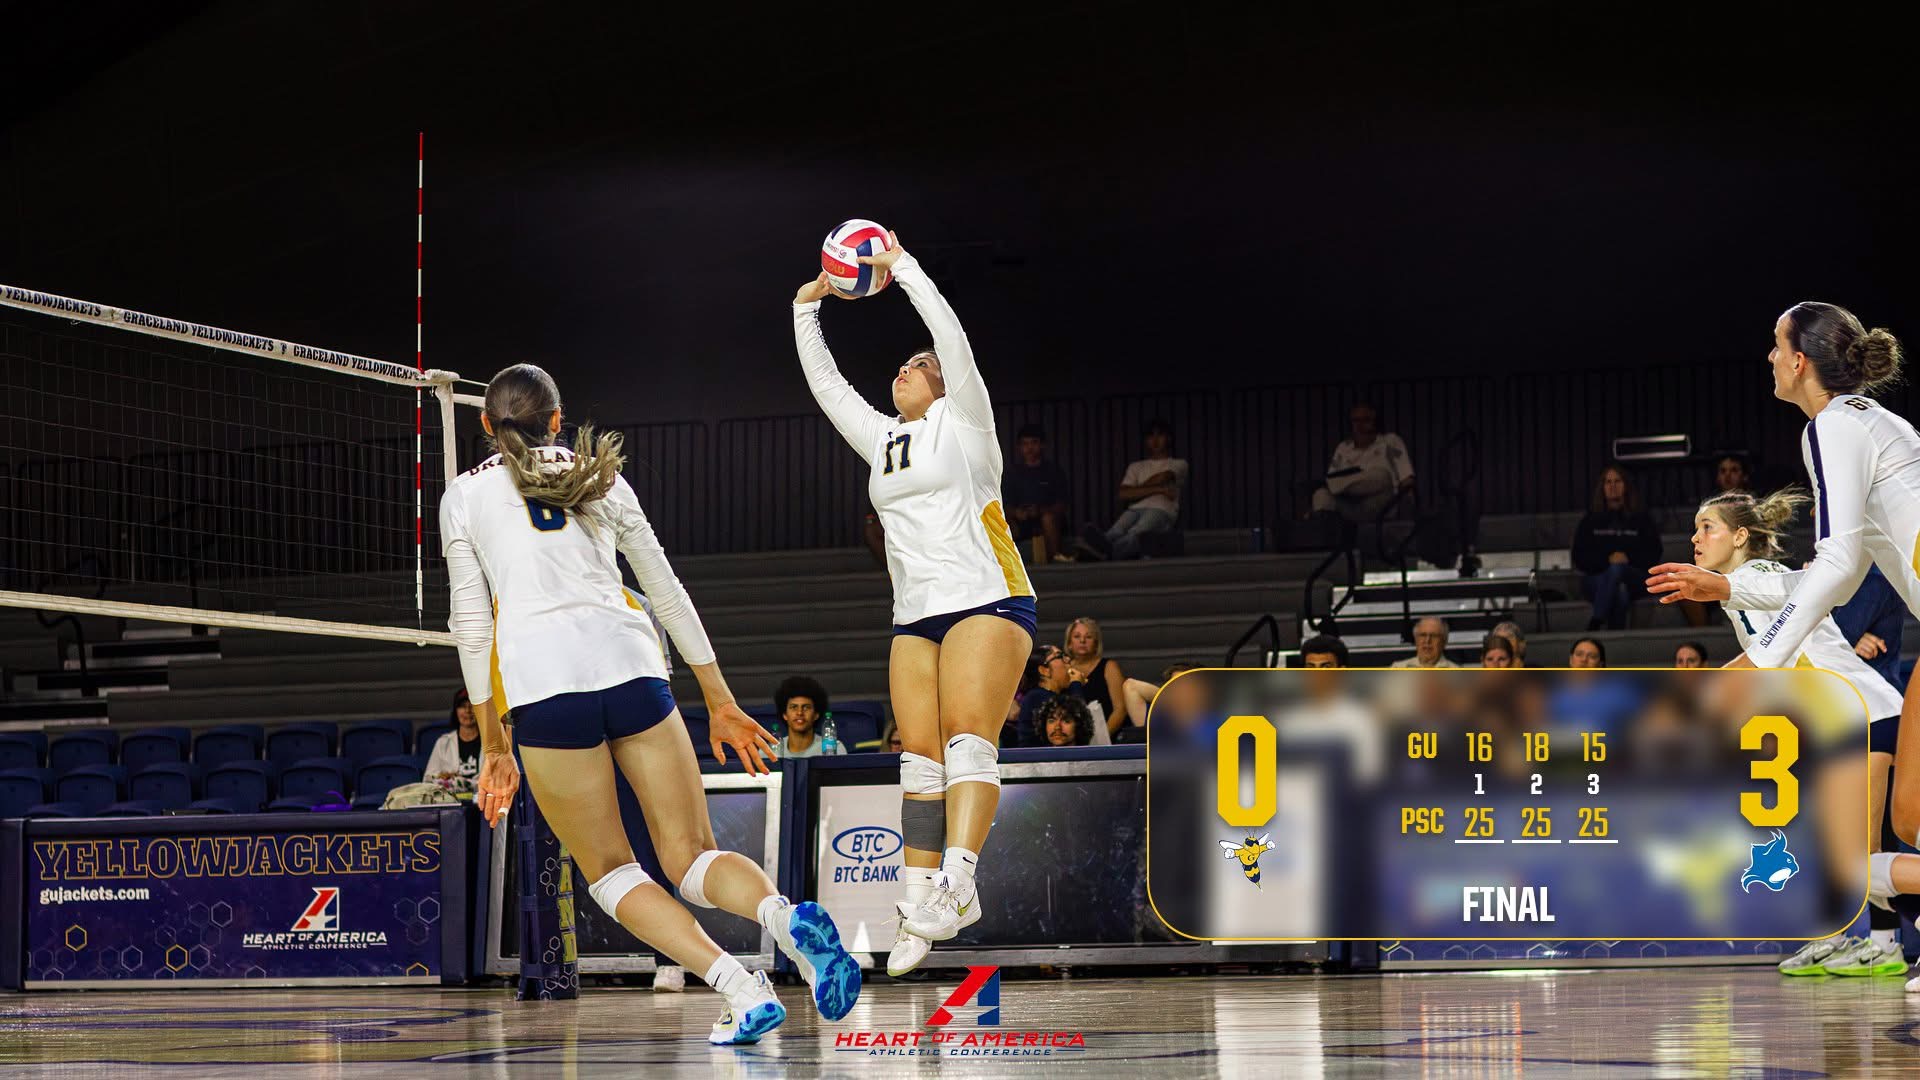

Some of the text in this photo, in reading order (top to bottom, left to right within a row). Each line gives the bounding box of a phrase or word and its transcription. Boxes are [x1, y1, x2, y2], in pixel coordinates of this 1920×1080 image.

[5, 286, 102, 317] YELLOWJACKETS
[123, 311, 189, 334] GRACELAND
[191, 325, 274, 351] YELLOWJACKETS
[293, 345, 350, 367] GRACELAND
[883, 433, 912, 476] 17
[851, 833, 885, 853] BTC
[33, 832, 440, 880] YELLOWJACKETS
[834, 864, 900, 883] BTC BANK
[40, 886, 150, 905] gujackets.com
[243, 931, 388, 945] HEART OF AMERICA
[262, 942, 368, 950] ATHLETIC CONFERENCE
